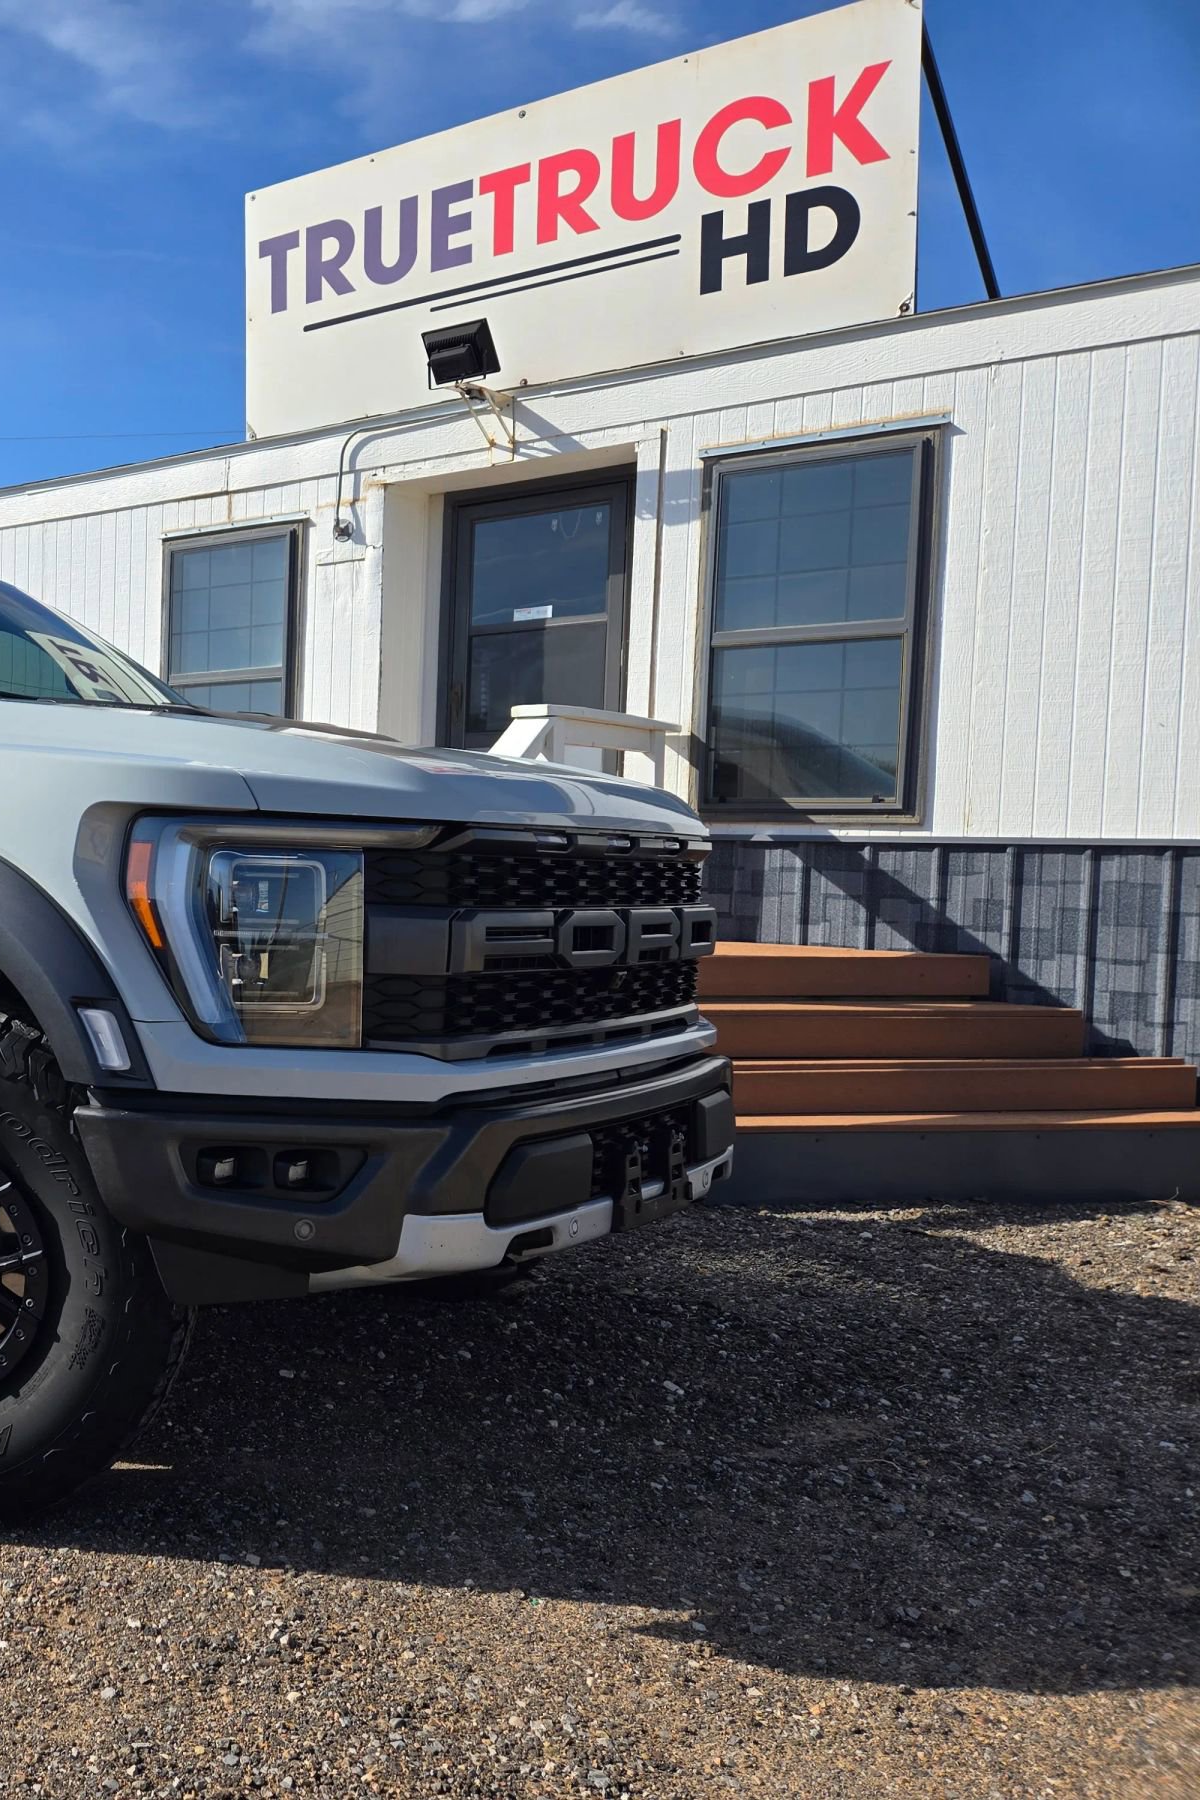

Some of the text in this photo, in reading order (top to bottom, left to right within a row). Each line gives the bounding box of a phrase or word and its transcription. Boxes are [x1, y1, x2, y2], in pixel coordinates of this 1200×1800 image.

[259, 59, 893, 315] TRUETRUCK
[700, 185, 861, 295] HD
[453, 906, 717, 972] FORD
